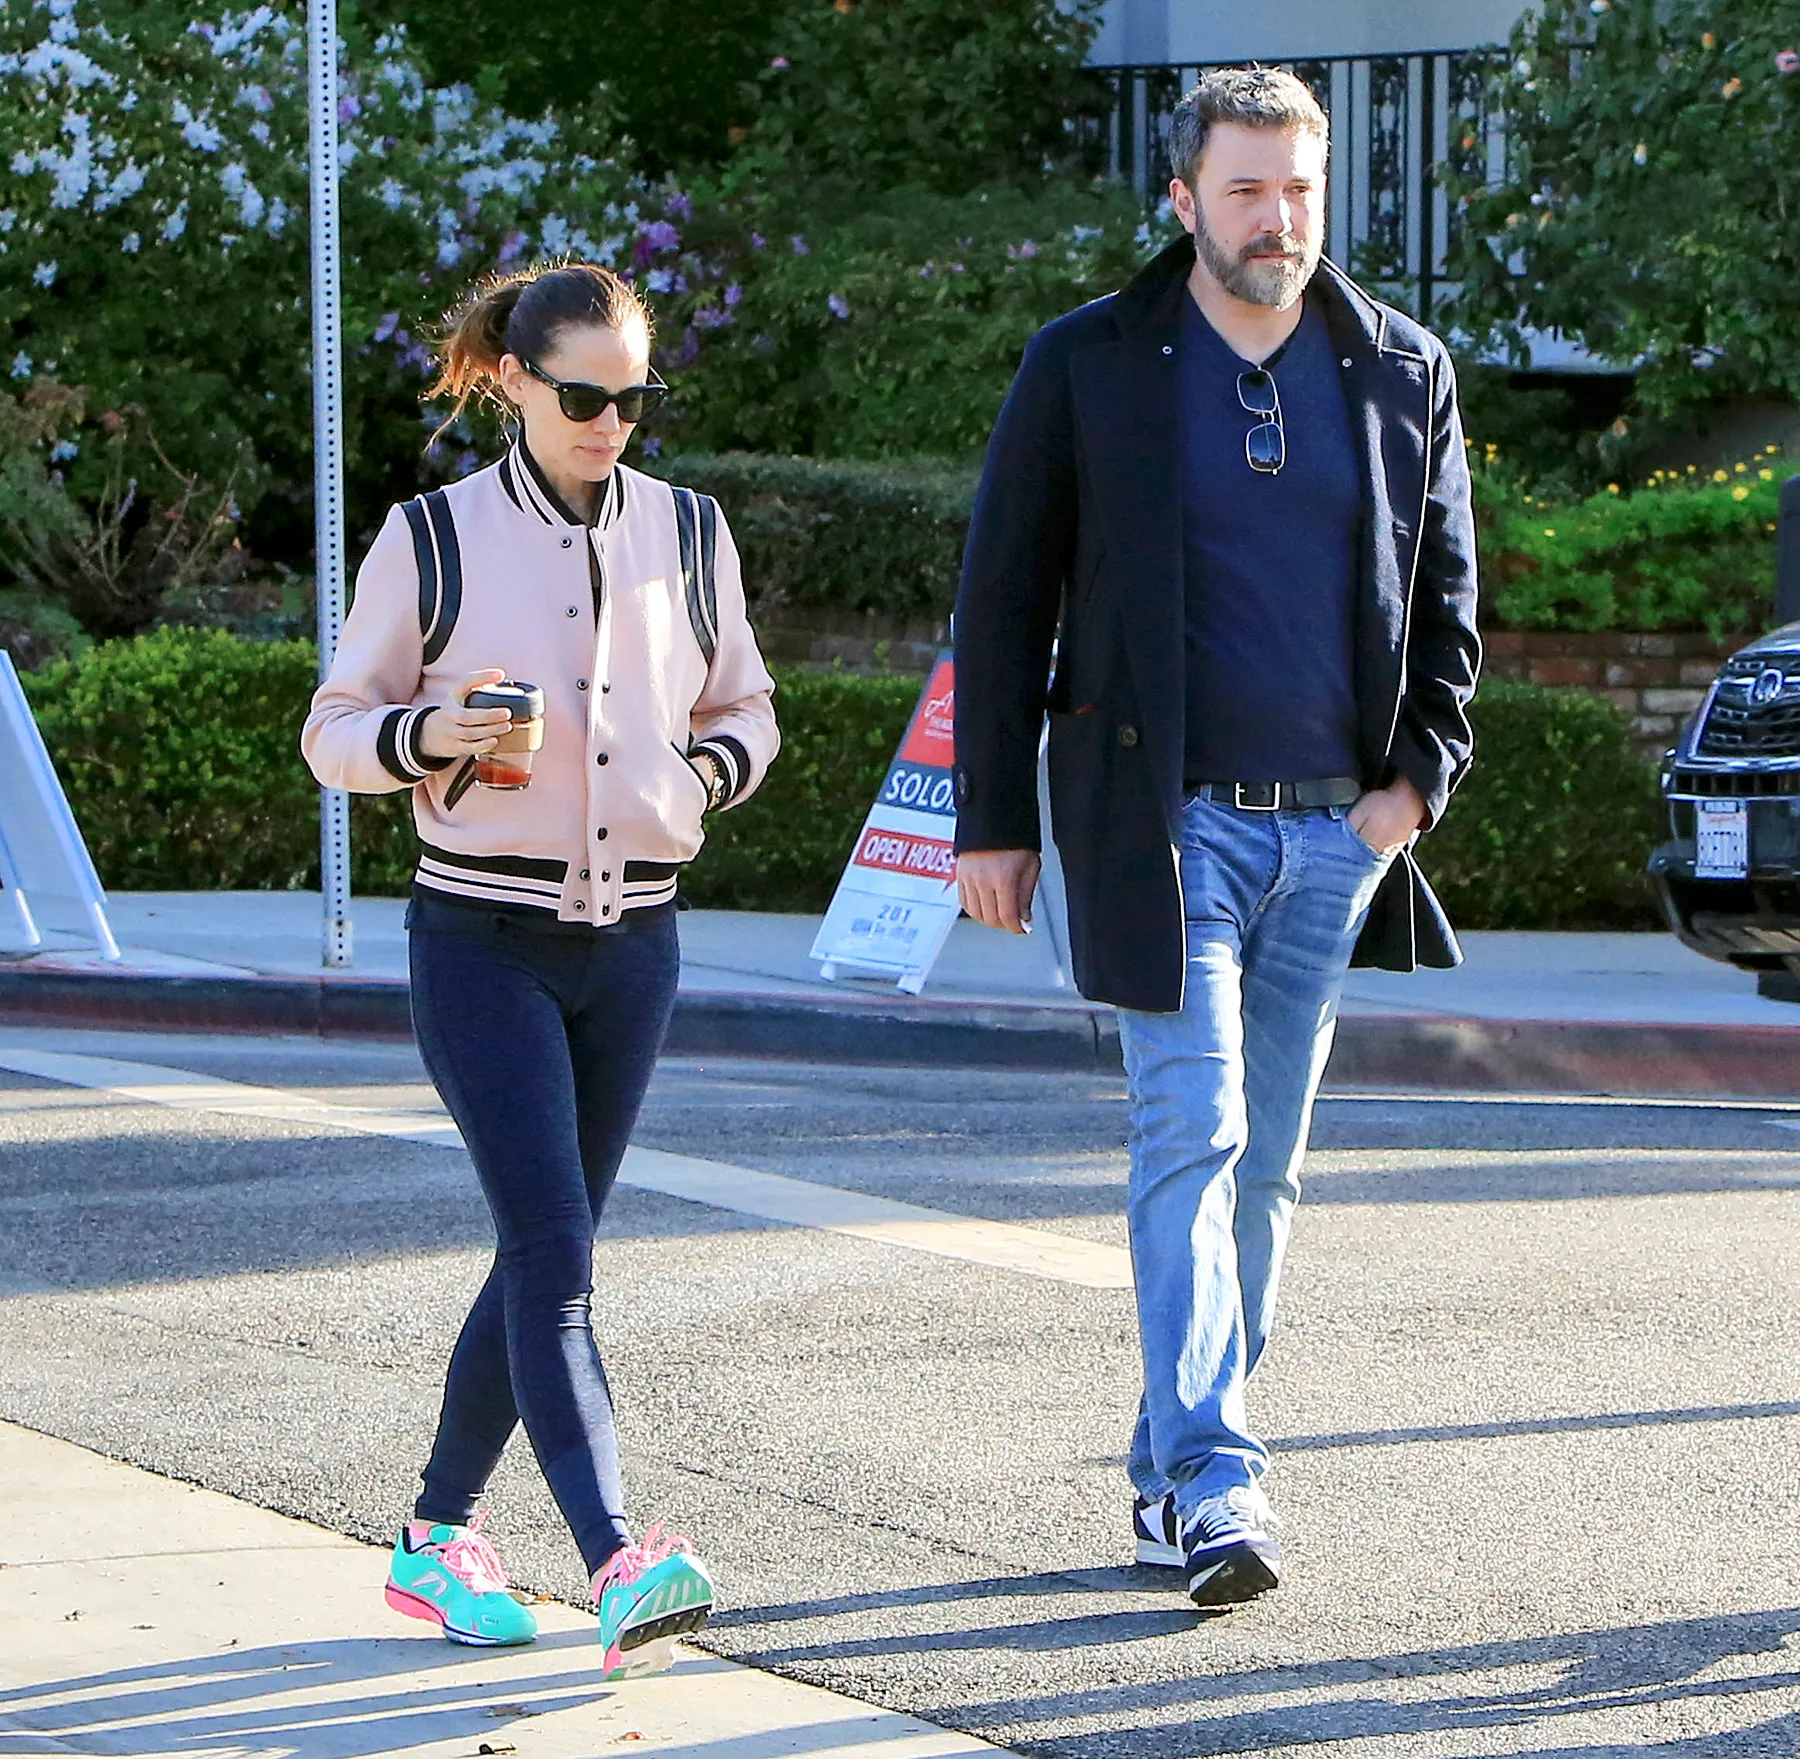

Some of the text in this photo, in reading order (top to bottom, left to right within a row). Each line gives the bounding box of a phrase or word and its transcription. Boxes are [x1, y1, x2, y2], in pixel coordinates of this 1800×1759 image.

[863, 835, 956, 873] OPEN HOUSE
[877, 904, 911, 923] 201
